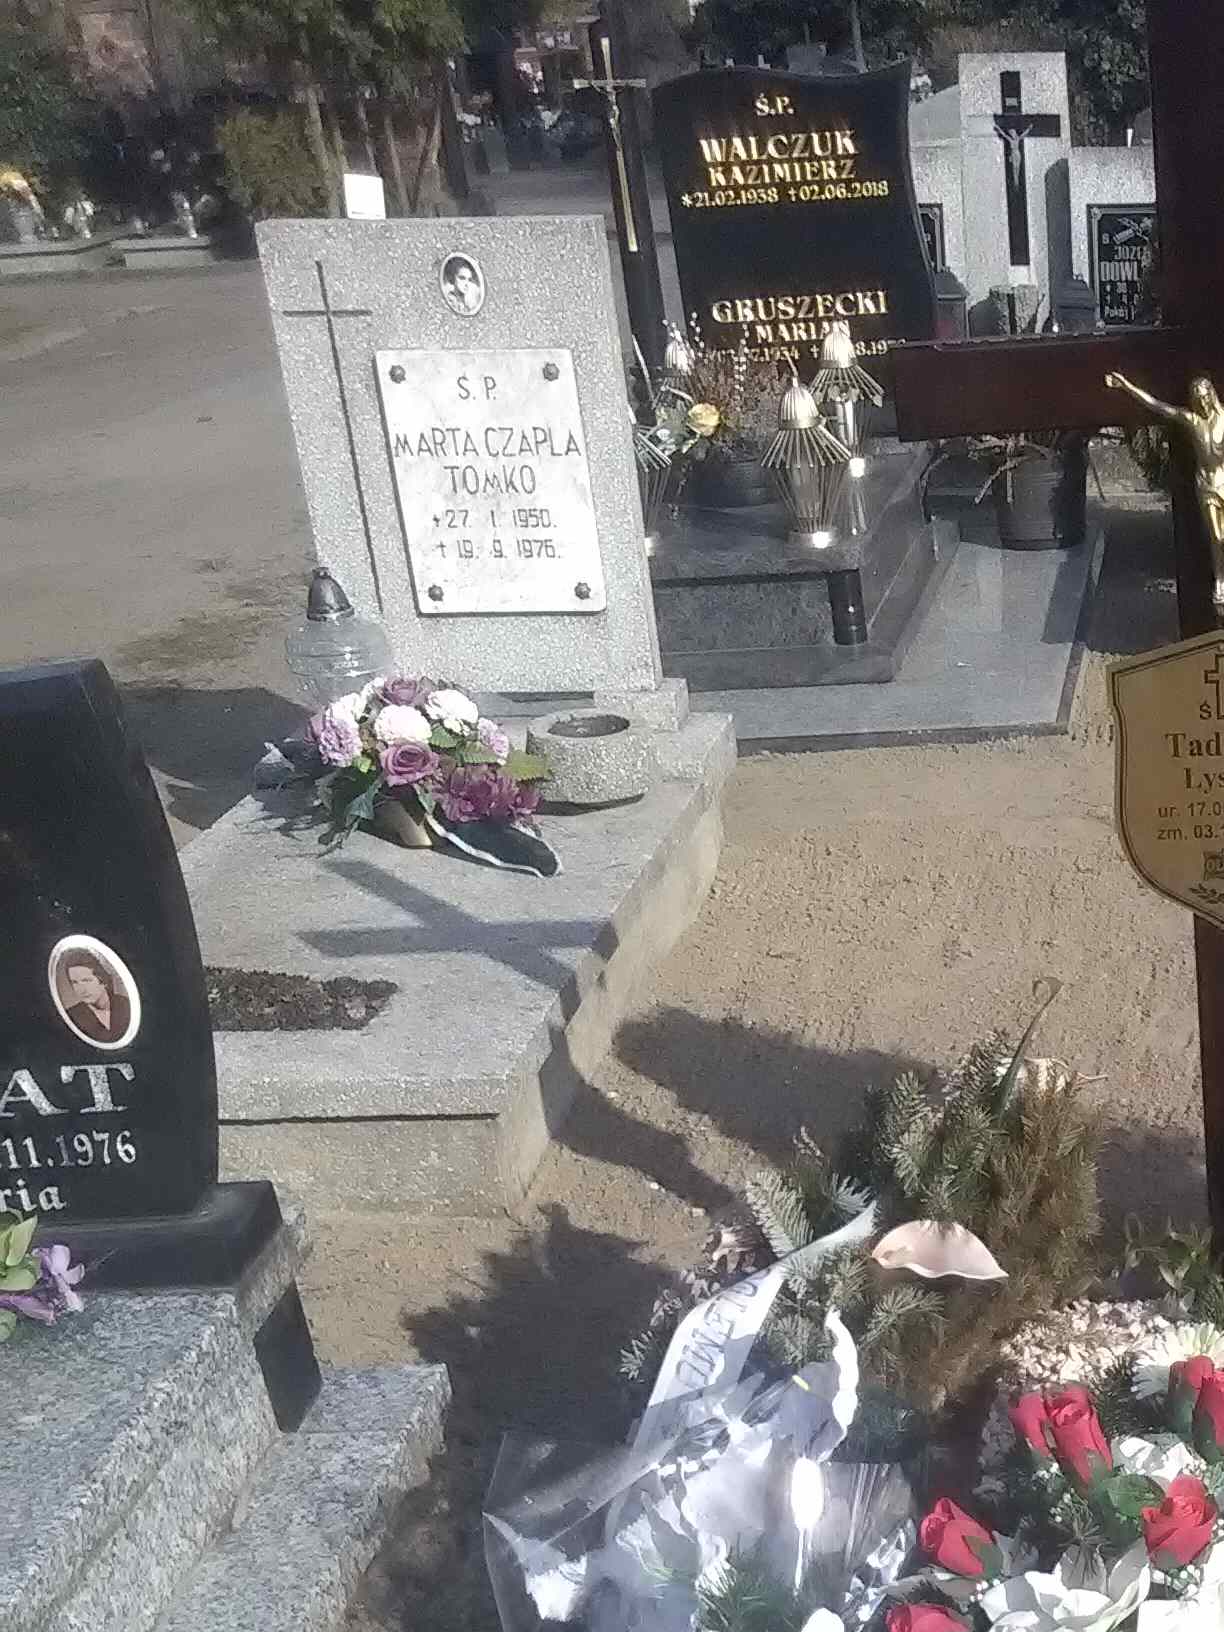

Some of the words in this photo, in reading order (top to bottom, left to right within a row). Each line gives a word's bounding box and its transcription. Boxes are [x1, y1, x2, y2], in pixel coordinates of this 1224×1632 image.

[699, 130, 859, 164] WALCZUK
[707, 158, 857, 188] KAZIMIERZ
[711, 290, 889, 324] GRUSZECKI
[394, 427, 480, 458] MARTA
[484, 426, 582, 458] CZAPLA
[443, 464, 537, 496] TOMKO
[1158, 804, 1181, 819] ur.
[1156, 826, 1188, 841] zm.
